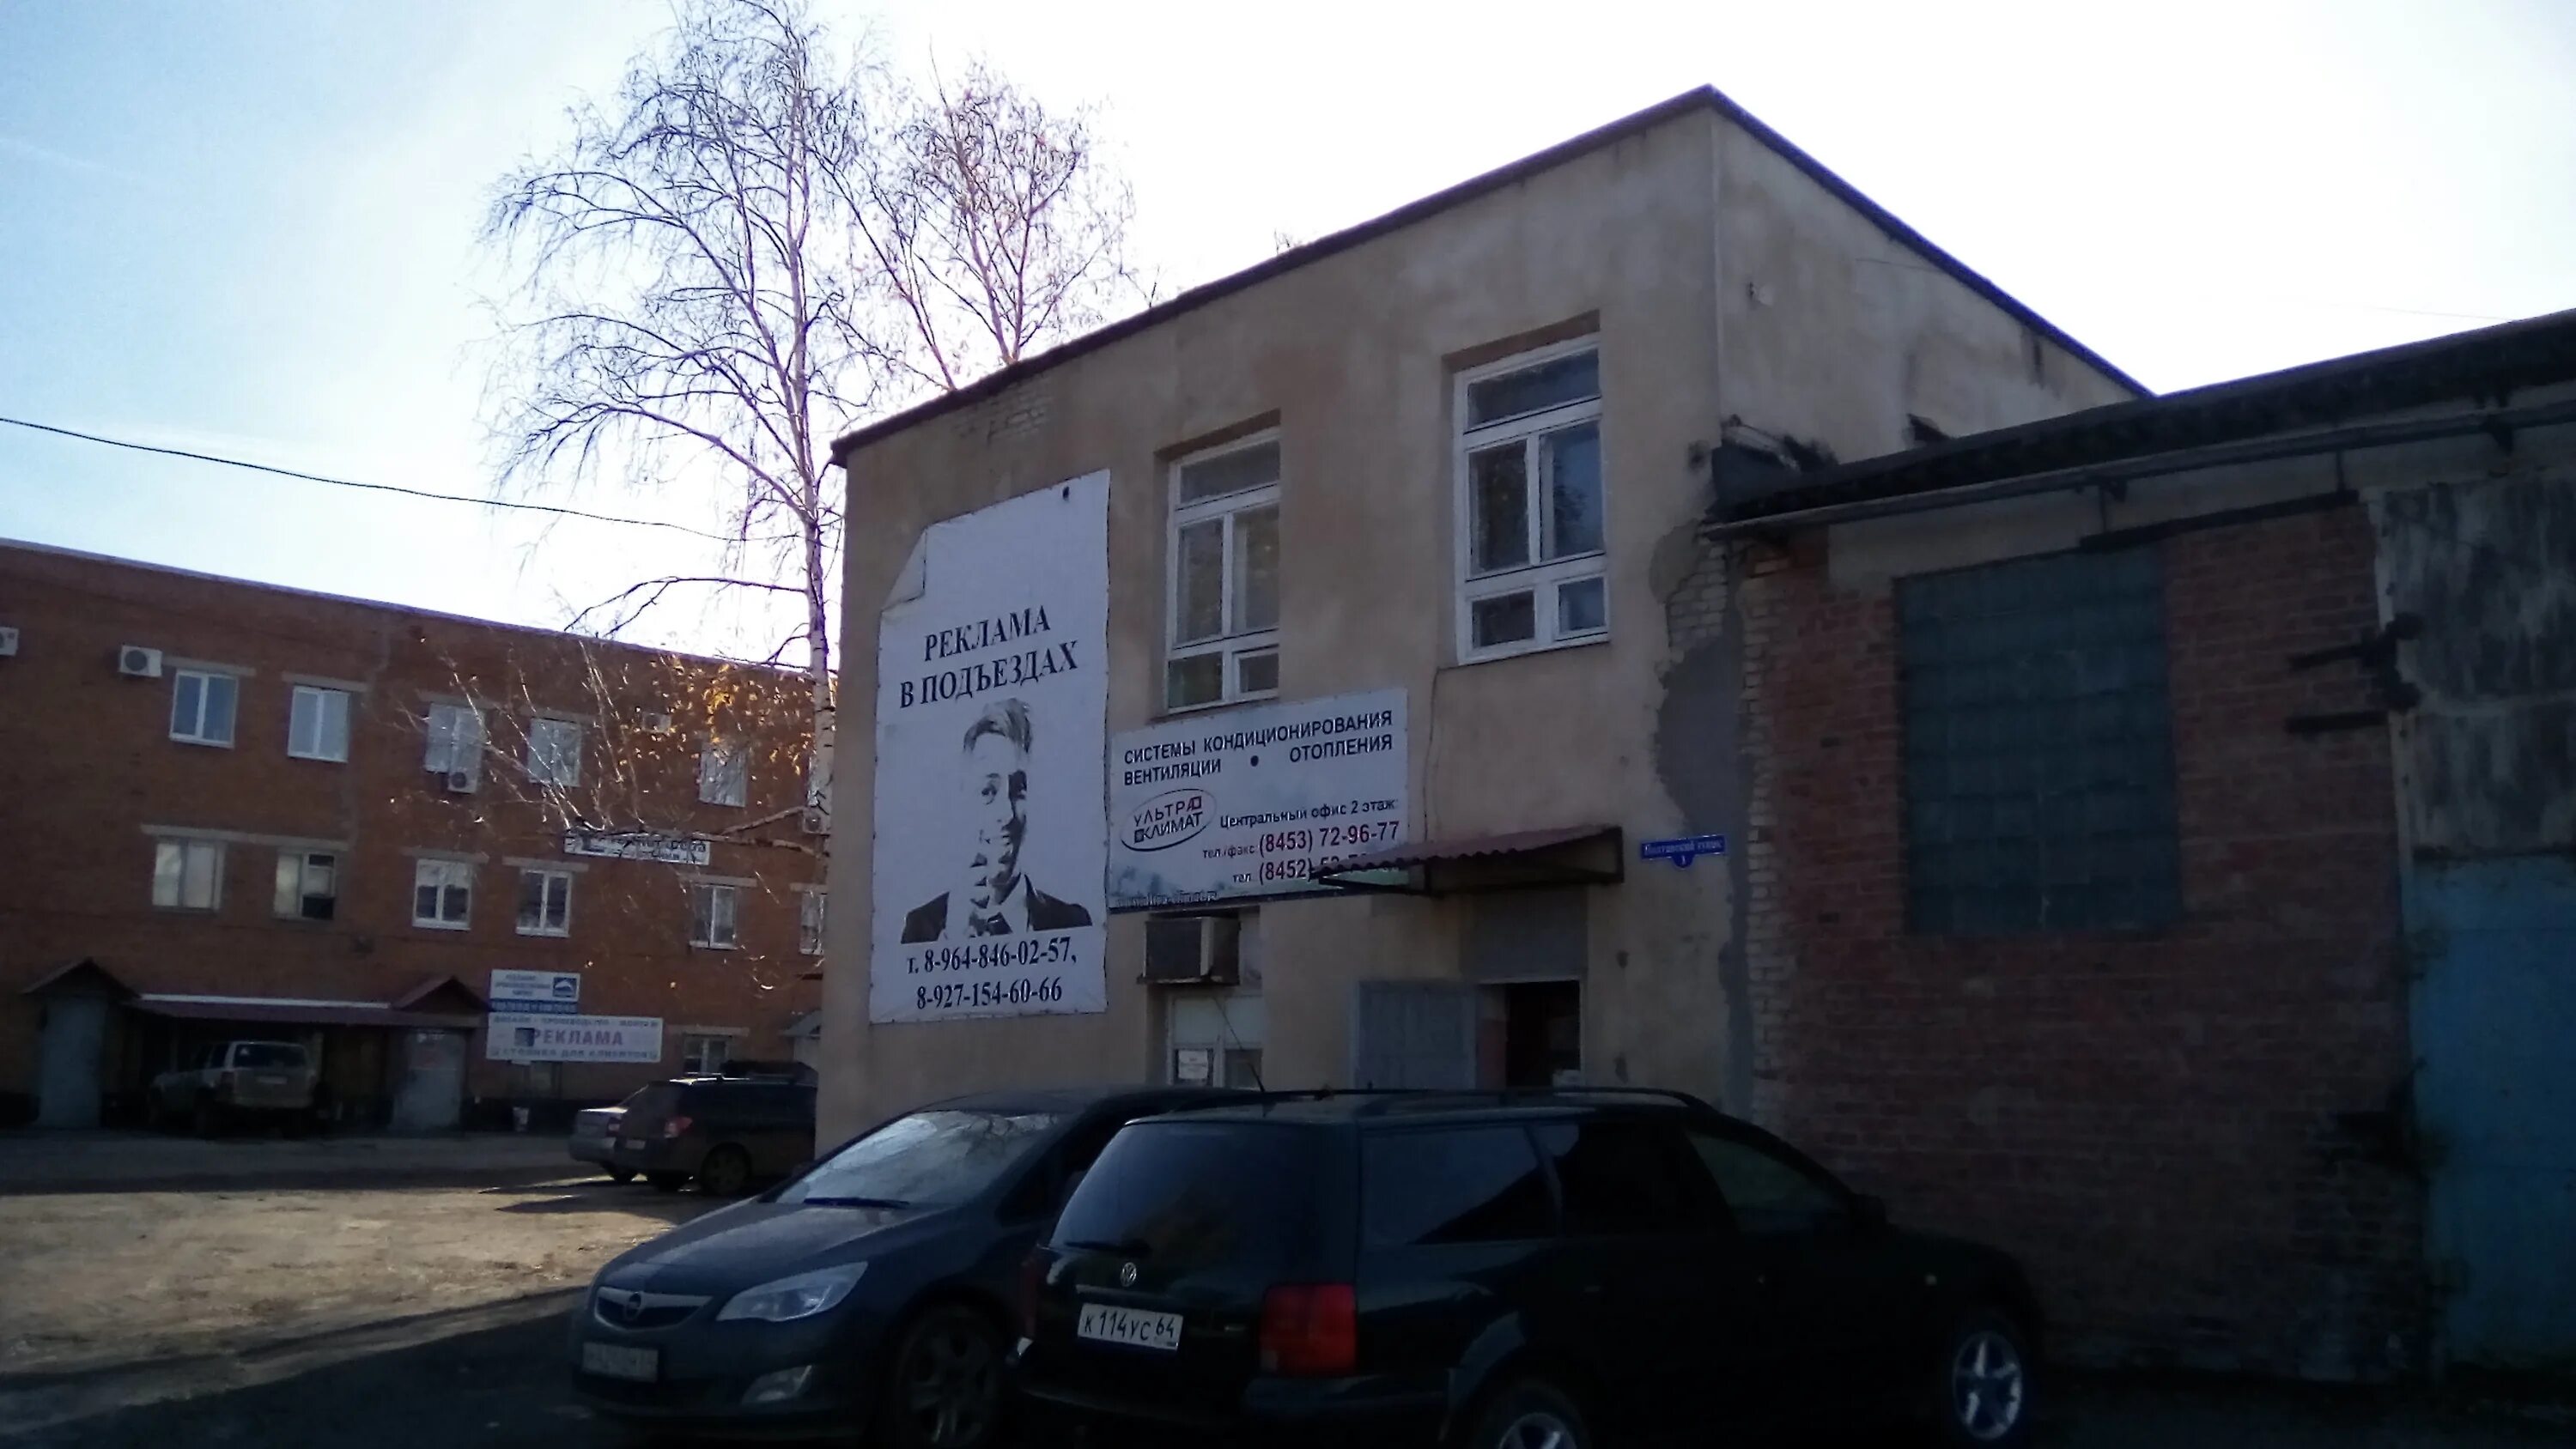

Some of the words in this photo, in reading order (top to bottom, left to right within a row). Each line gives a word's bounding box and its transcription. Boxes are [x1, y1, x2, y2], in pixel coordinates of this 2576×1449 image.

[923, 604, 1051, 662] РЕКЛАМА
[900, 681, 914, 709] В
[920, 640, 1078, 704] ПОДЪЕЗДАХ
[1124, 740, 1195, 765] СИСТЕМЫ
[1203, 710, 1393, 753] КОНДИЦИОНИРОВАНИЯ
[1124, 758, 1221, 786] ВЕНТИЛЯЦИИ
[1290, 734, 1393, 763] ОТОПЛЕНИЯ
[1133, 796, 1197, 827] УЛЬТРА
[1143, 811, 1203, 840] КЛИМАТ
[1311, 803, 1346, 820] офис
[1351, 800, 1358, 815] 2
[1362, 798, 1396, 813] этаж
[1260, 829, 1313, 858] (8453)
[1319, 821, 1400, 847] 72-96-77
[924, 937, 1077, 973] 8-964-846-02-57,
[917, 977, 1062, 1009] 8-927-154-60-66
[532, 1028, 623, 1046] РЕКЛАМА
